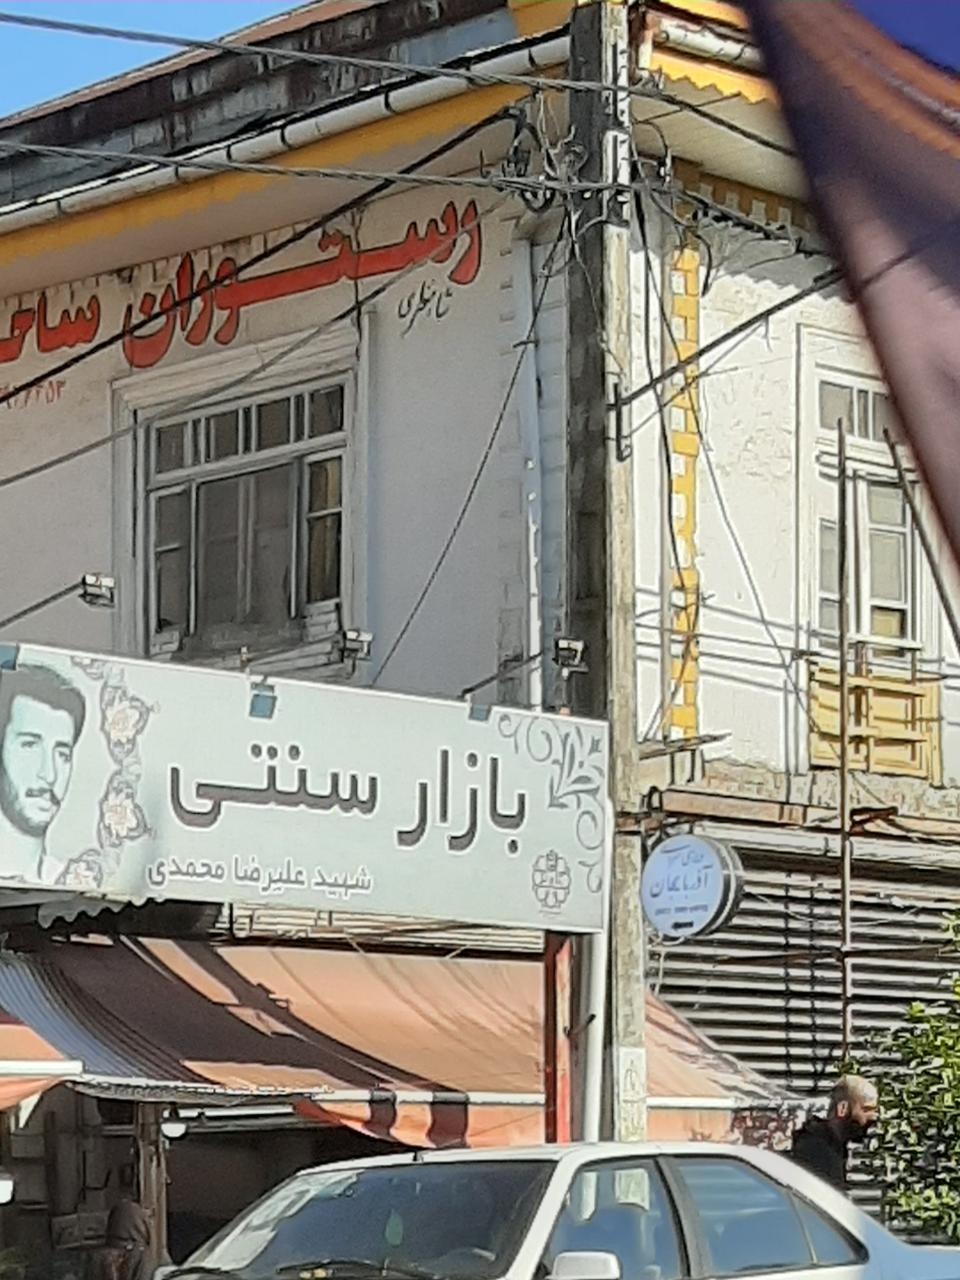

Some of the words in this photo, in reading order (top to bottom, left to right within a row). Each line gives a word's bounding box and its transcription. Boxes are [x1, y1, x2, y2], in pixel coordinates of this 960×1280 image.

[123, 200, 481, 368] رستوران
[170, 744, 378, 829] سنتی
[396, 749, 527, 855] بازار
[148, 859, 225, 886] محمدی
[234, 856, 306, 893] علیرضا
[313, 866, 372, 897] شهید
